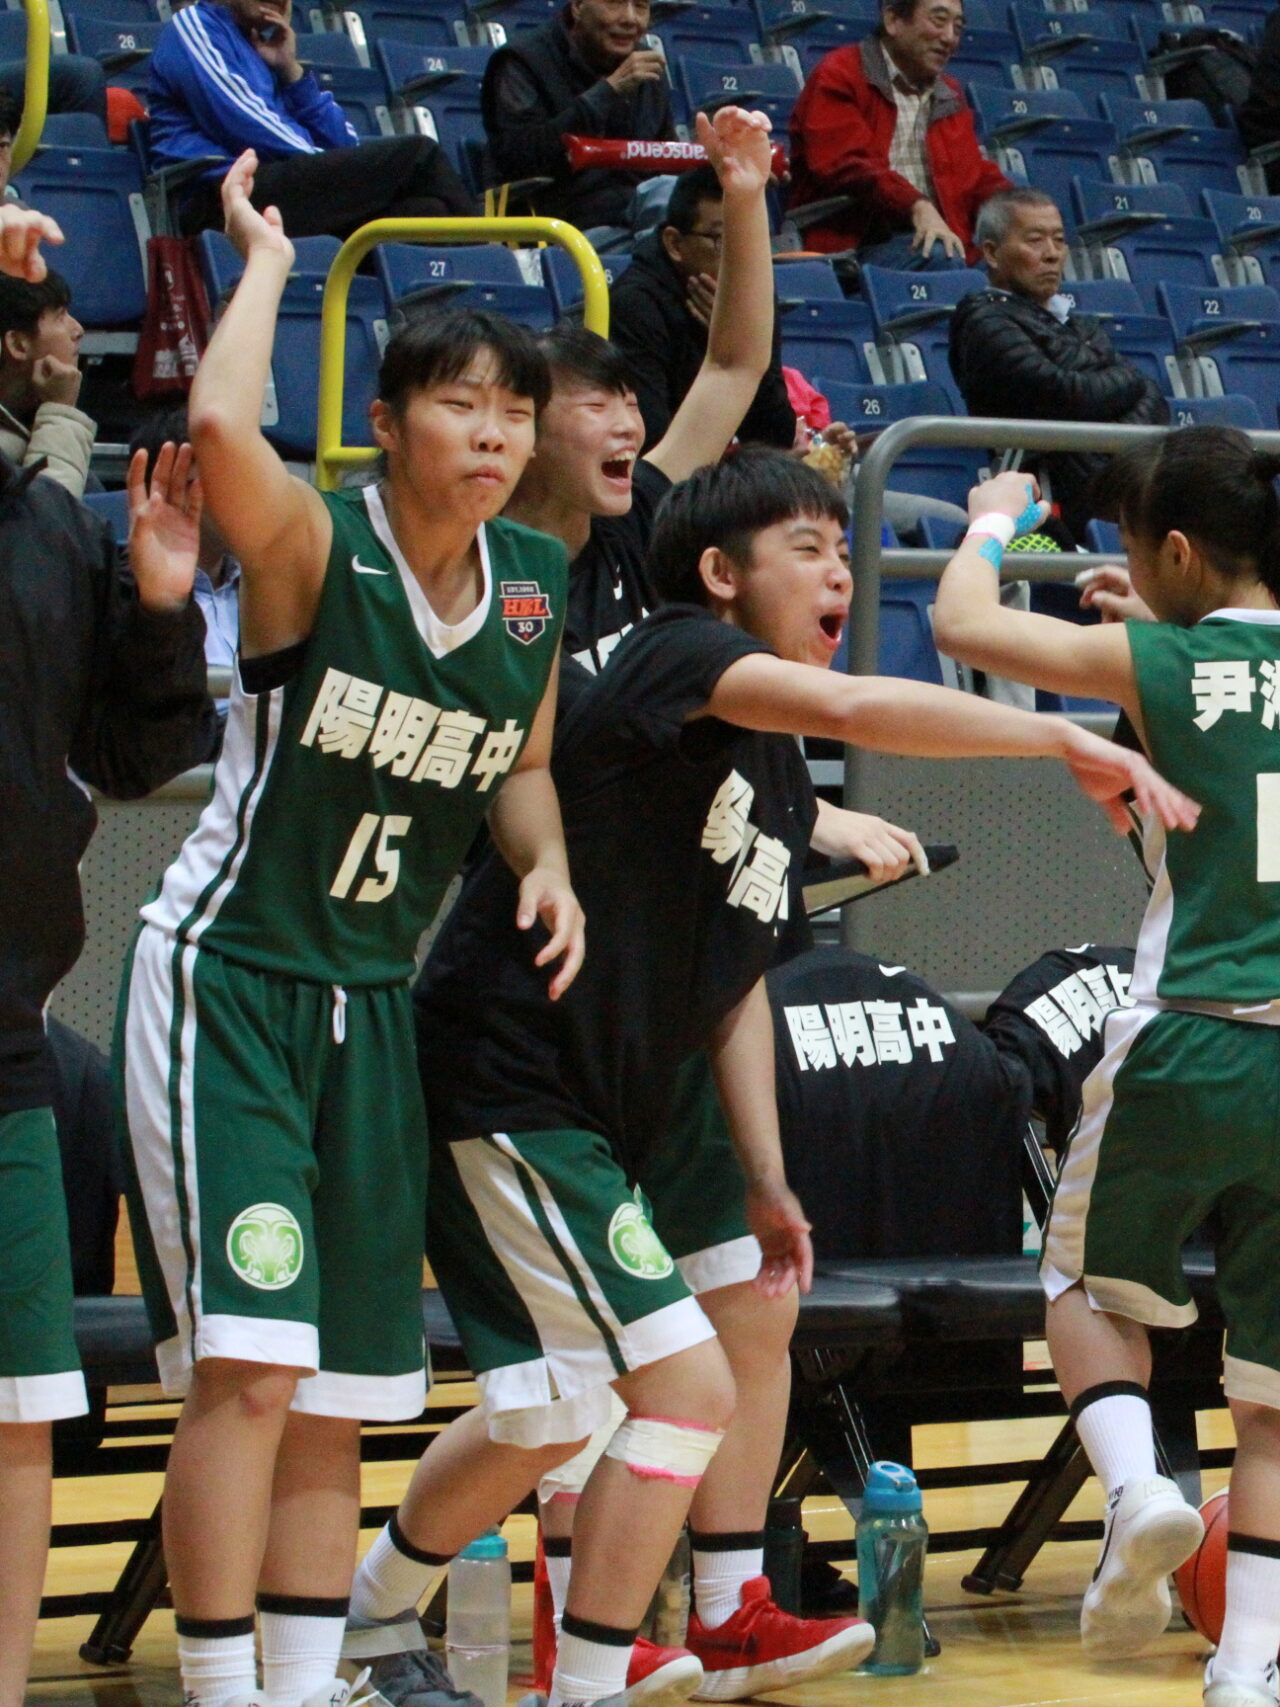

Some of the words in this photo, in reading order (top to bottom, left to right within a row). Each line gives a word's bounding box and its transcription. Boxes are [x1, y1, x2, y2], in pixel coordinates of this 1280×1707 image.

[118, 35, 135, 50] 26
[427, 58, 443, 72] 24
[722, 76, 738, 91] 22
[1013, 101, 1027, 114] 20
[1115, 196, 1129, 210] 21
[1246, 207, 1262, 221] 20
[429, 261, 446, 276] 27
[911, 285, 927, 300] 24
[1204, 300, 1220, 314] 22
[863, 399, 880, 415] 26
[518, 621, 533, 633] 30
[300, 667, 524, 792] 陽明高中
[329, 812, 413, 903] 15
[784, 998, 957, 1072] 陽明高中
